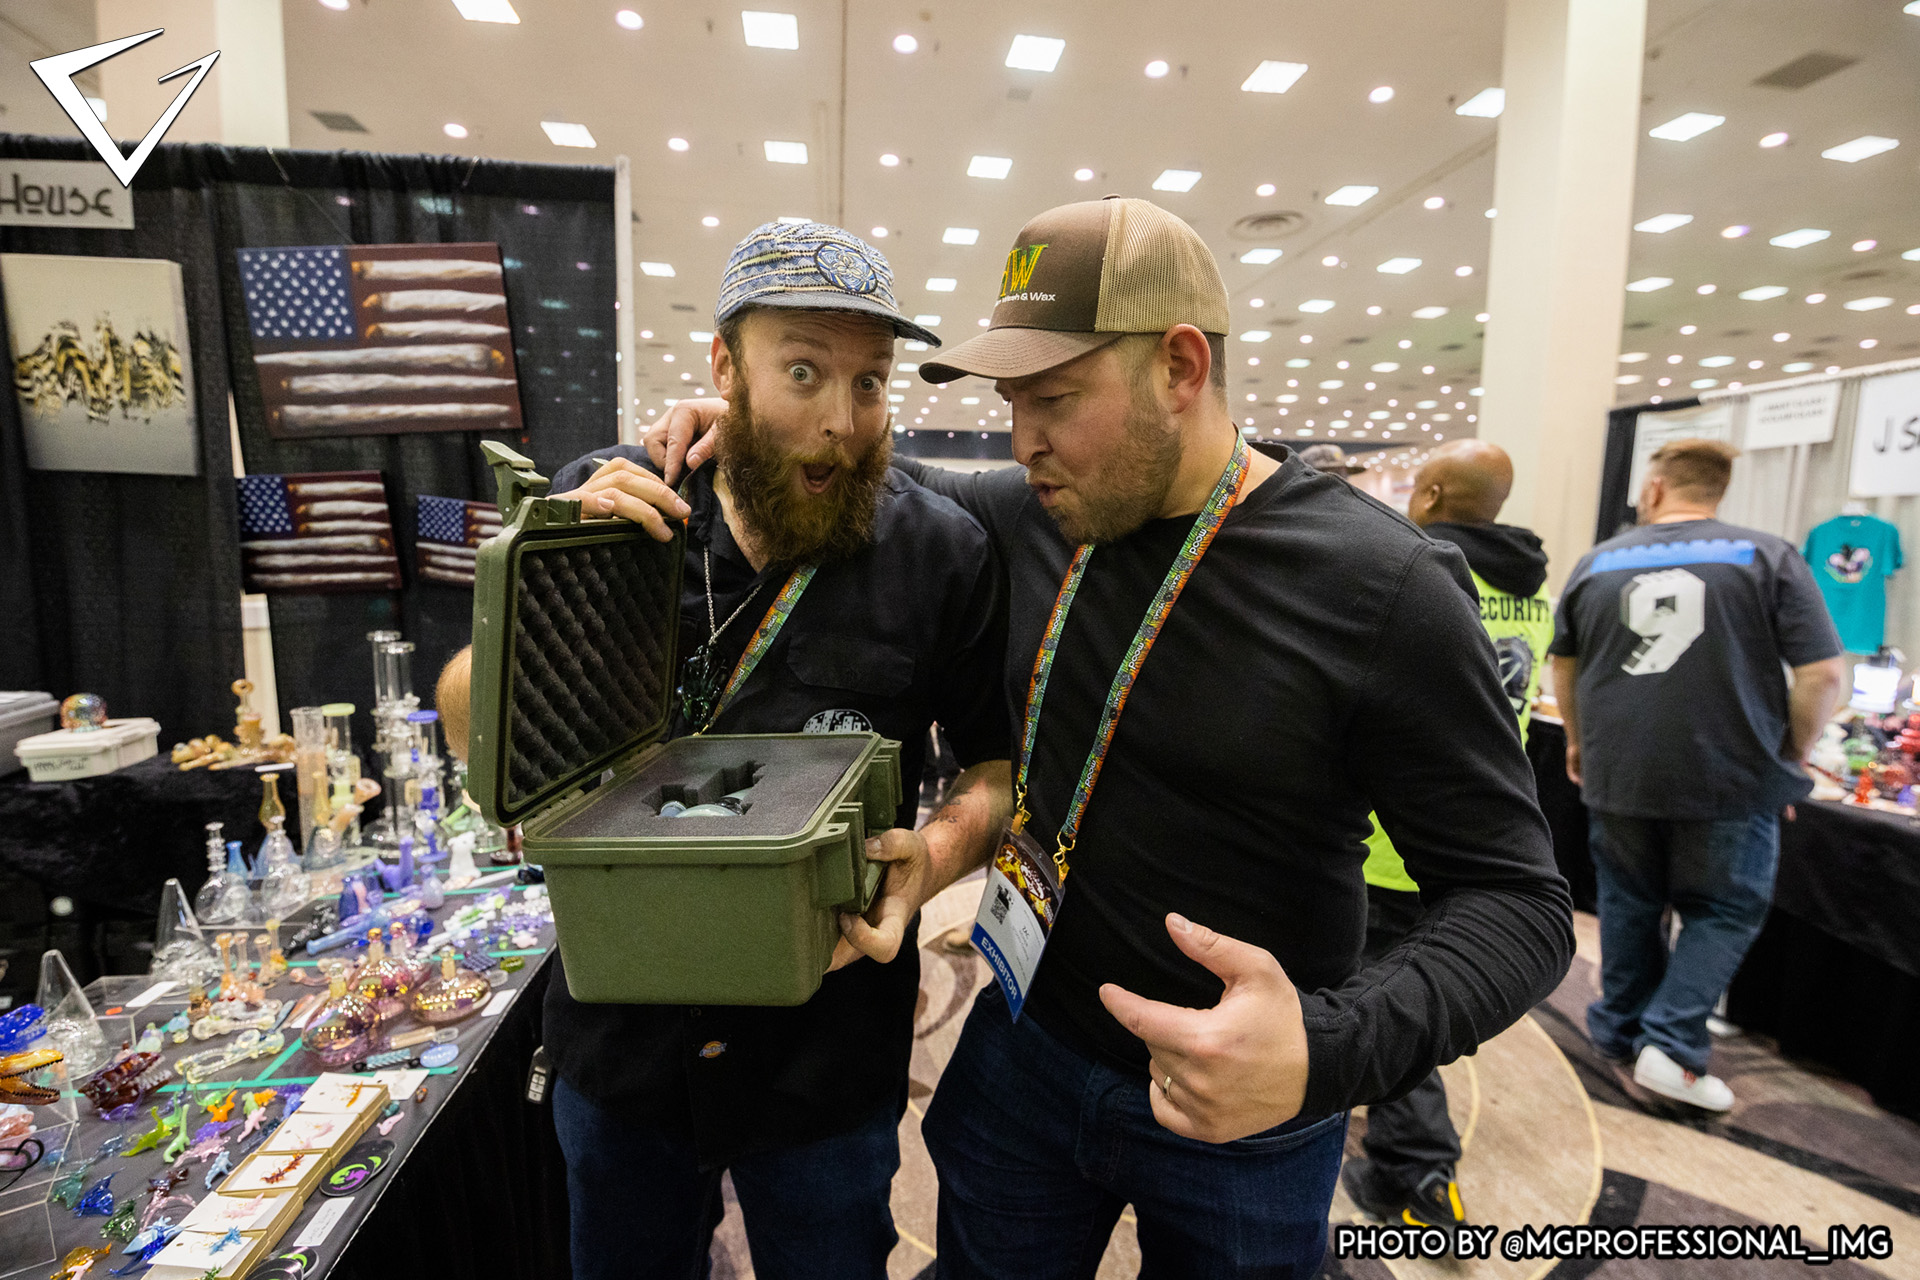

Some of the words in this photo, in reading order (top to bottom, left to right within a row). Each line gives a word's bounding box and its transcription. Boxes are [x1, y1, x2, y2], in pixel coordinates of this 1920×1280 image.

[1030, 292, 1056, 301] Wax
[1189, 527, 1207, 556] mood
[785, 577, 801, 599] mood
[1051, 609, 1063, 634] mood
[1621, 567, 1706, 676] 9
[1128, 642, 1145, 670] mood
[730, 667, 745, 691] mood
[1025, 721, 1033, 748] mood
[1085, 759, 1097, 788] mood
[981, 936, 1018, 1000] EXHIBITOR
